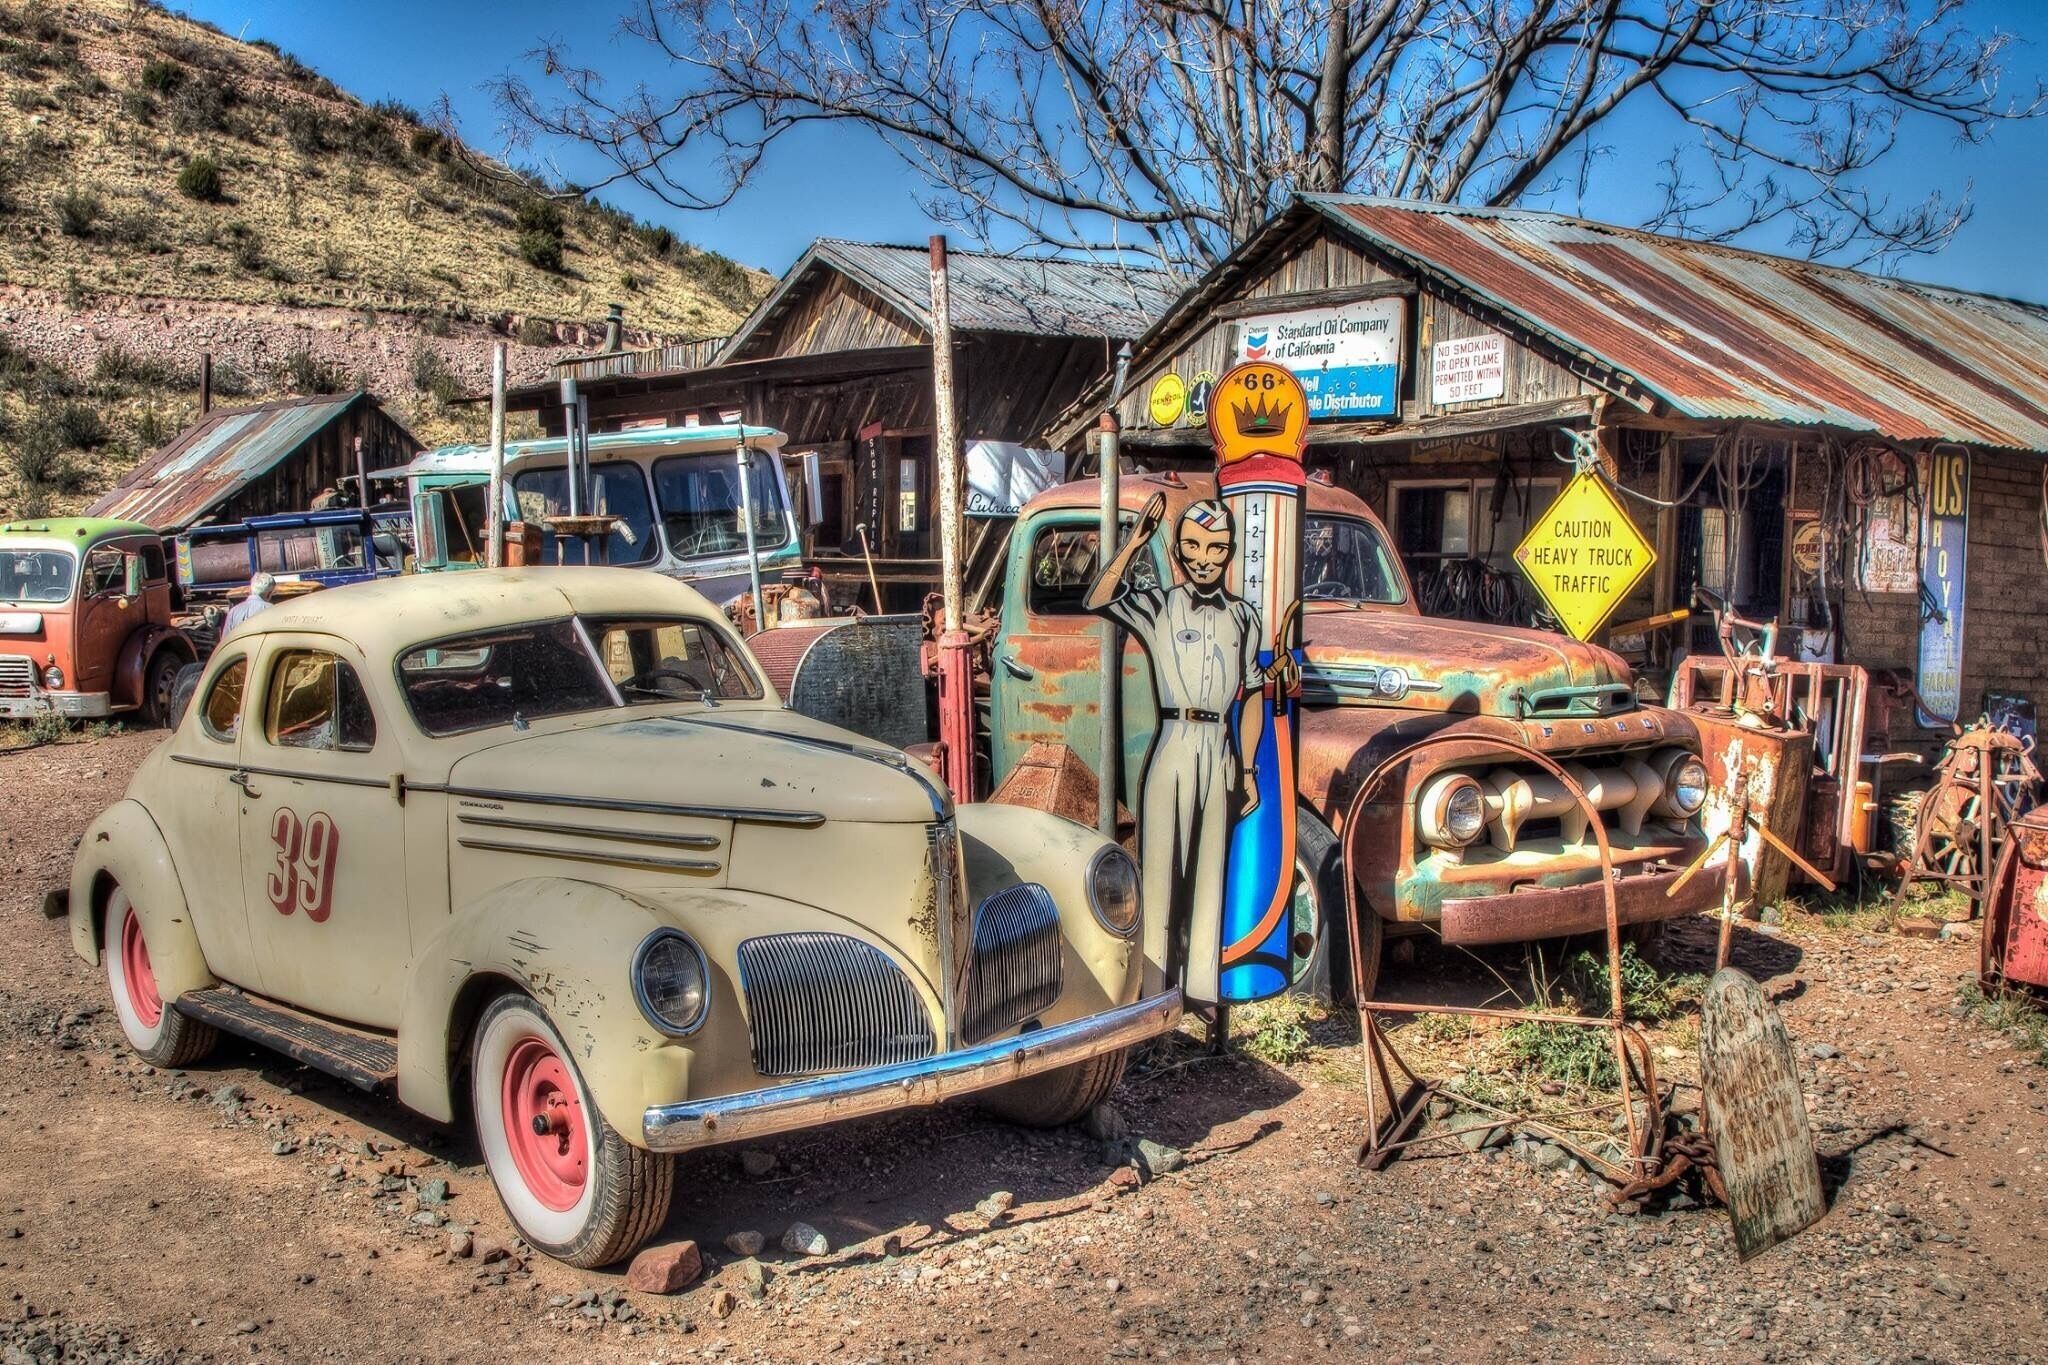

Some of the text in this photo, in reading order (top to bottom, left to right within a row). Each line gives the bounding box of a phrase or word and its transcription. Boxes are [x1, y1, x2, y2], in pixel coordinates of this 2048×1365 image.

[1277, 318, 1390, 340] Standard Oil Company
[1275, 340, 1335, 359] of California
[1438, 339, 1498, 357] NO SMOKING
[1435, 352, 1500, 372] OR OPEN FLAME
[1434, 366, 1501, 386] PERMITTED WITHIN
[1464, 383, 1483, 396] FEET
[1323, 392, 1383, 410] Distributor
[869, 439, 878, 550] SHOE REPAIR
[1933, 454, 1965, 516] U.S.
[961, 493, 1027, 514] Lubrica
[1252, 503, 1259, 516] 1
[1252, 526, 1259, 538] 2
[1554, 520, 1612, 539] CAUTION
[1251, 550, 1259, 563] 3
[1534, 547, 1633, 566] HEAVY TRUCK
[1249, 575, 1257, 588] 4
[1553, 574, 1611, 593] TRAFFIC
[267, 806, 340, 923] 39
